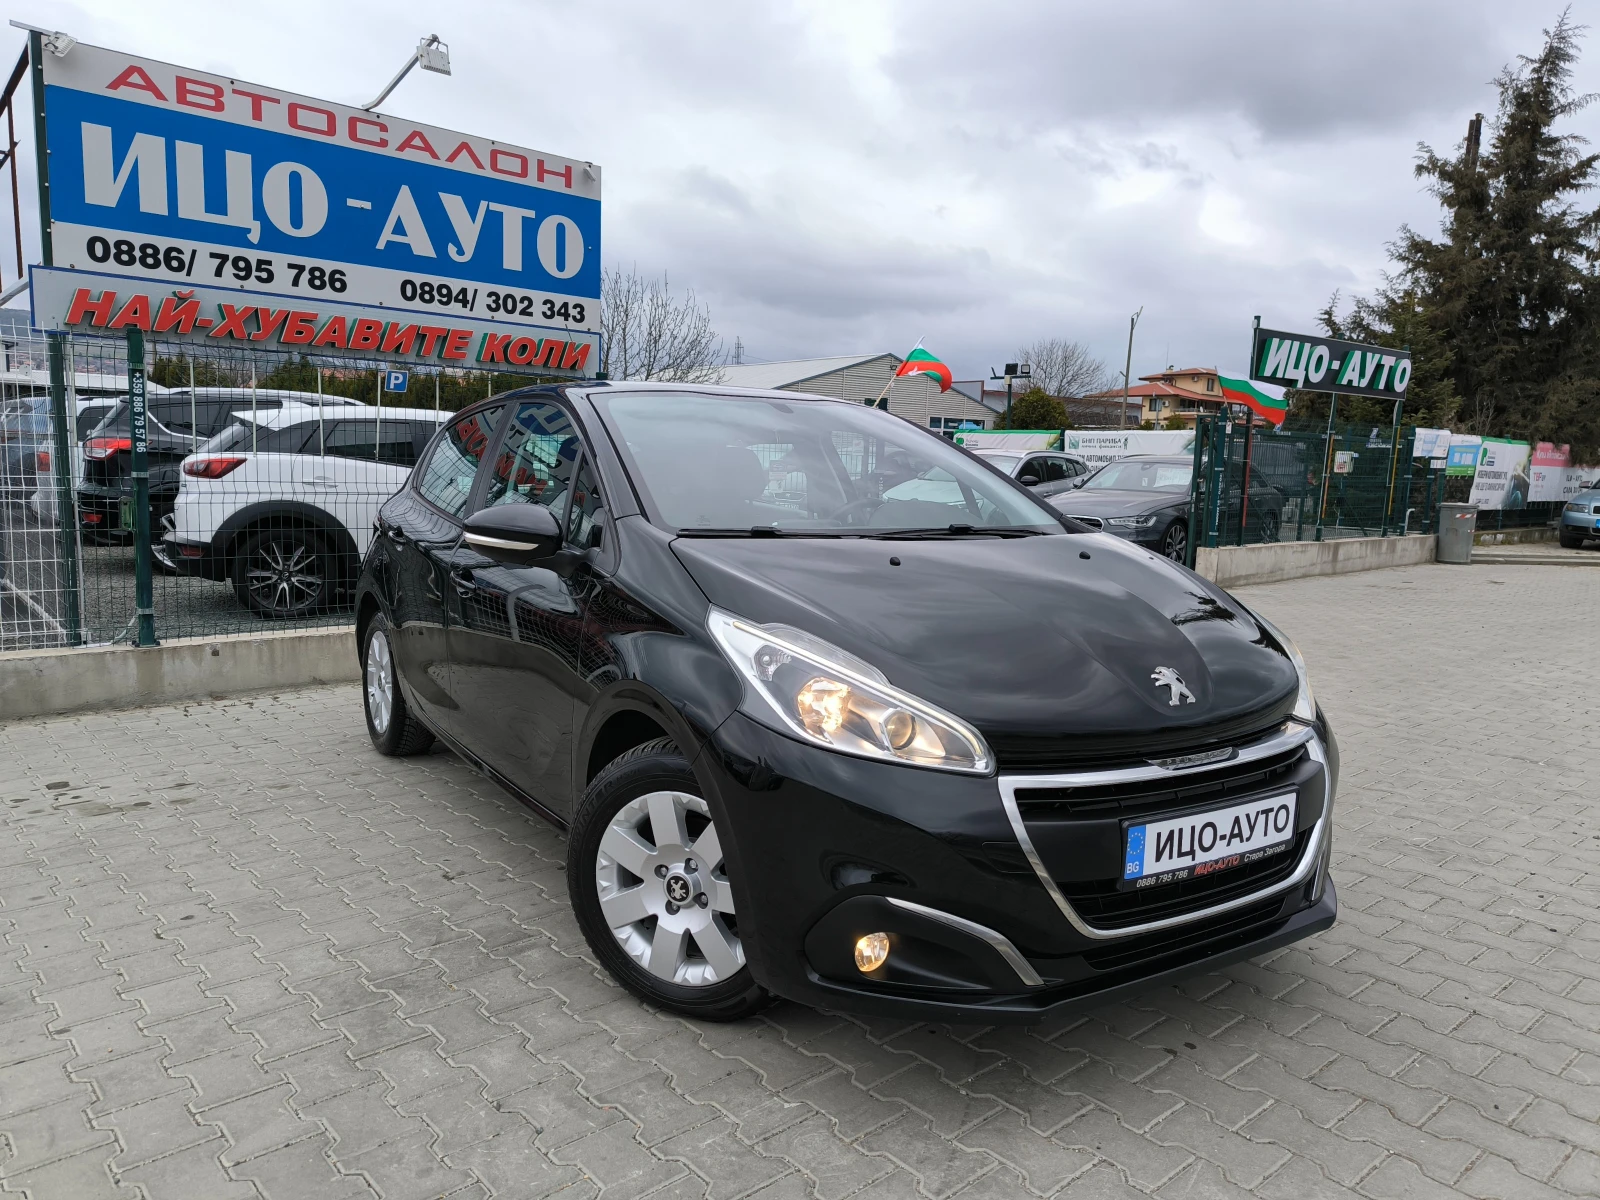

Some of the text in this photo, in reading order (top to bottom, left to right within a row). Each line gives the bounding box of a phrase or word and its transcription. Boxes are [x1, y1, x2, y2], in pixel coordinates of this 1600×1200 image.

[106, 65, 573, 189] АВТОСАЛОН
[209, 251, 276, 285] 795
[286, 263, 348, 294] 786
[486, 291, 534, 318] 302
[541, 298, 586, 324] 343
[64, 287, 591, 371] НАЙ-ХУБАВИТЕ КОЛИ
[1260, 338, 1412, 393] ИЦО-АУТО
[132, 371, 147, 453] +359 886 79 57 86
[1136, 844, 1286, 888] 0886 795 786 ИЦО-АУТО Стара Загора
[1154, 804, 1290, 863] ИЦО-АУТО
[1126, 861, 1140, 874] BG
